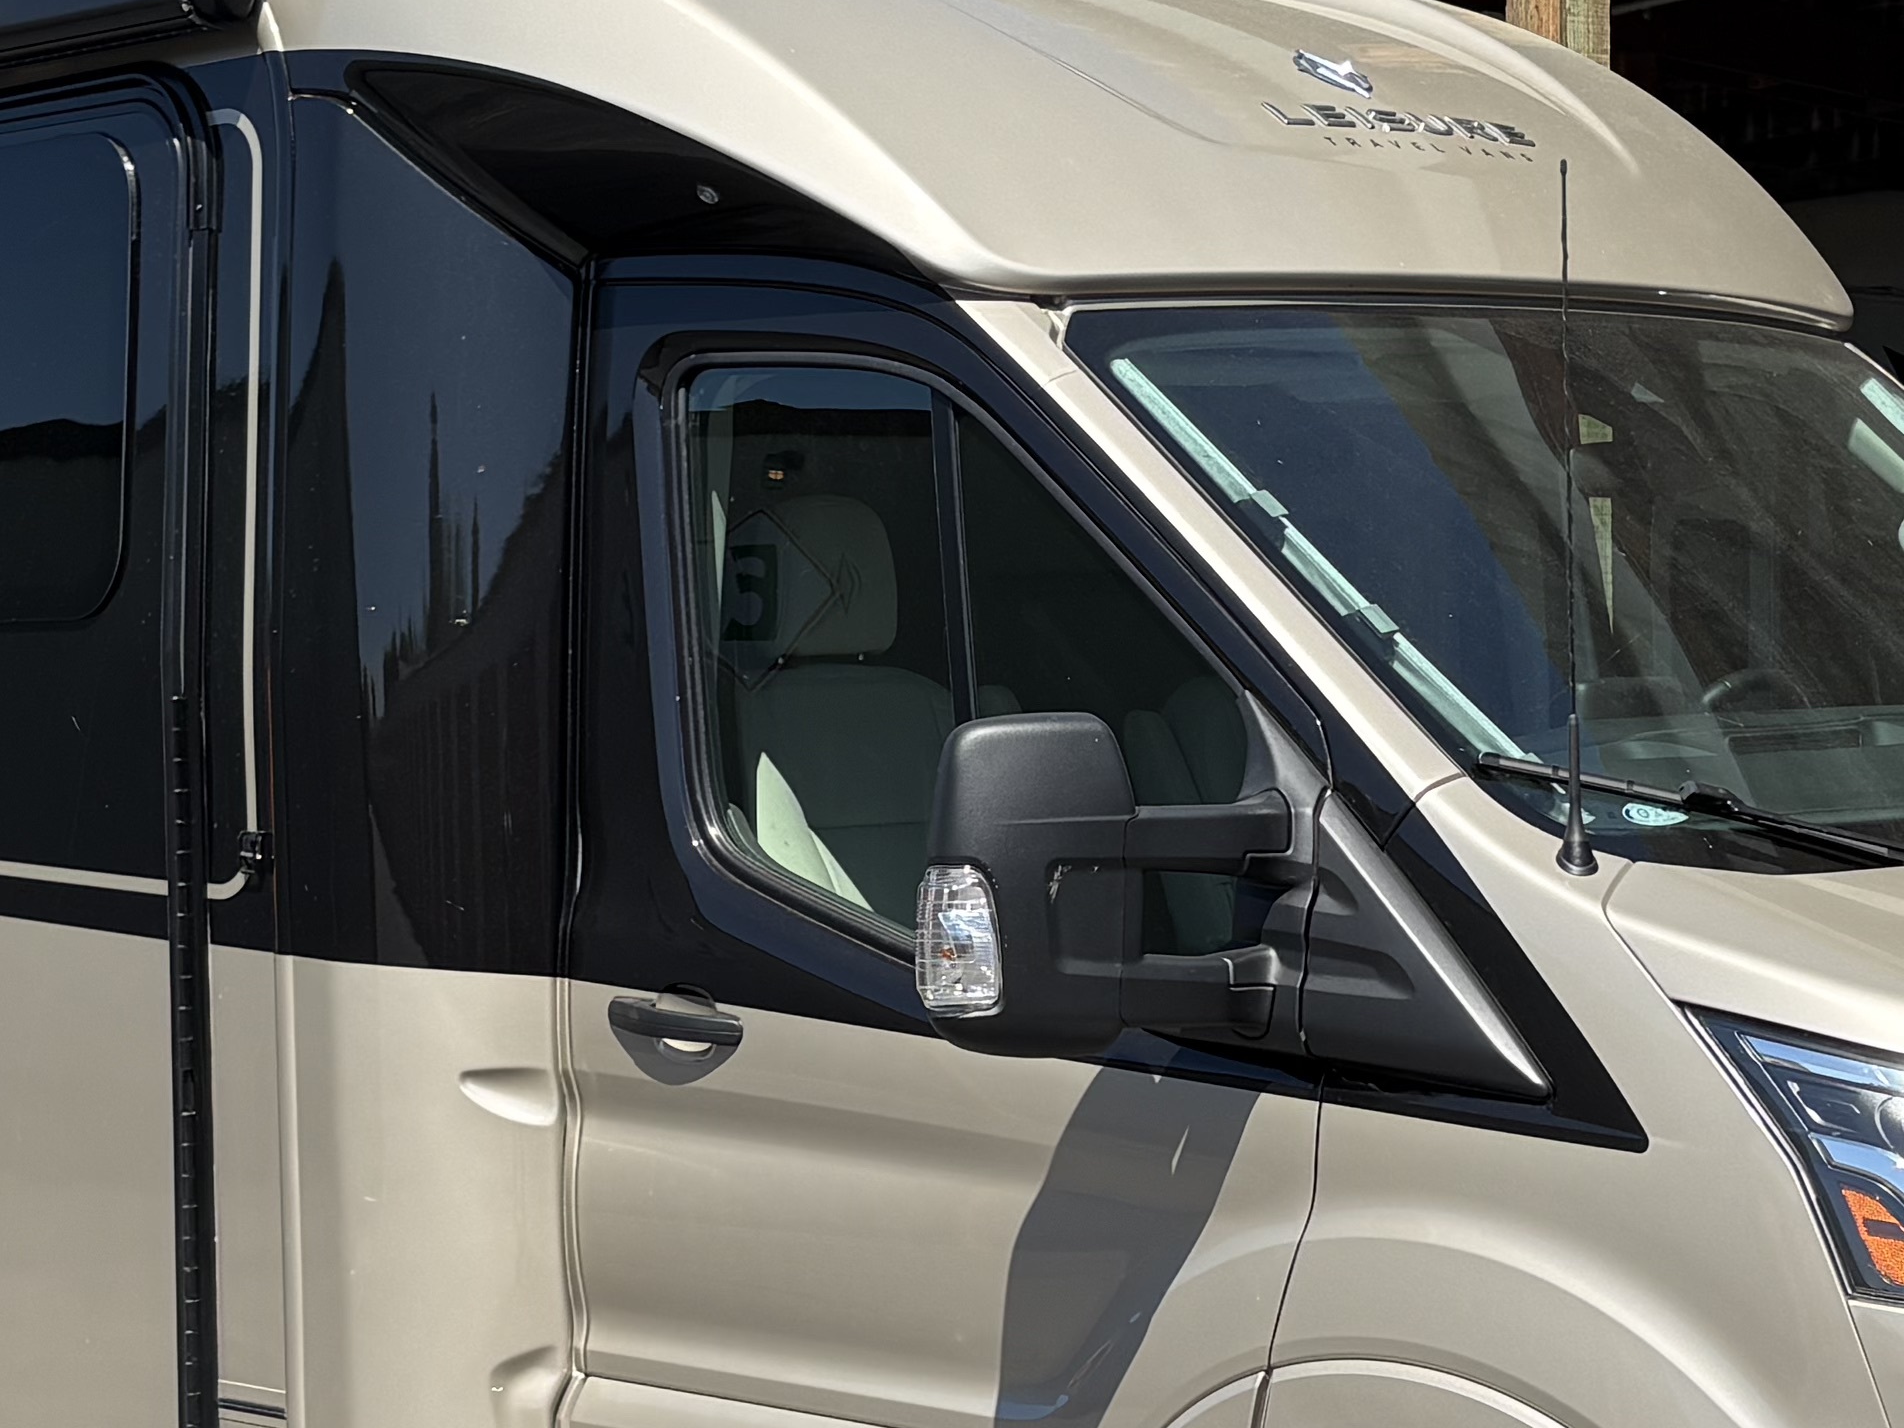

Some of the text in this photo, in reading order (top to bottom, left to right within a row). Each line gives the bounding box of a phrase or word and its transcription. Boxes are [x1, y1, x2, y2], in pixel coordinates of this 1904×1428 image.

[1260, 100, 1536, 148] LEISURE
[1323, 135, 1534, 163] TRAVEL VANS
